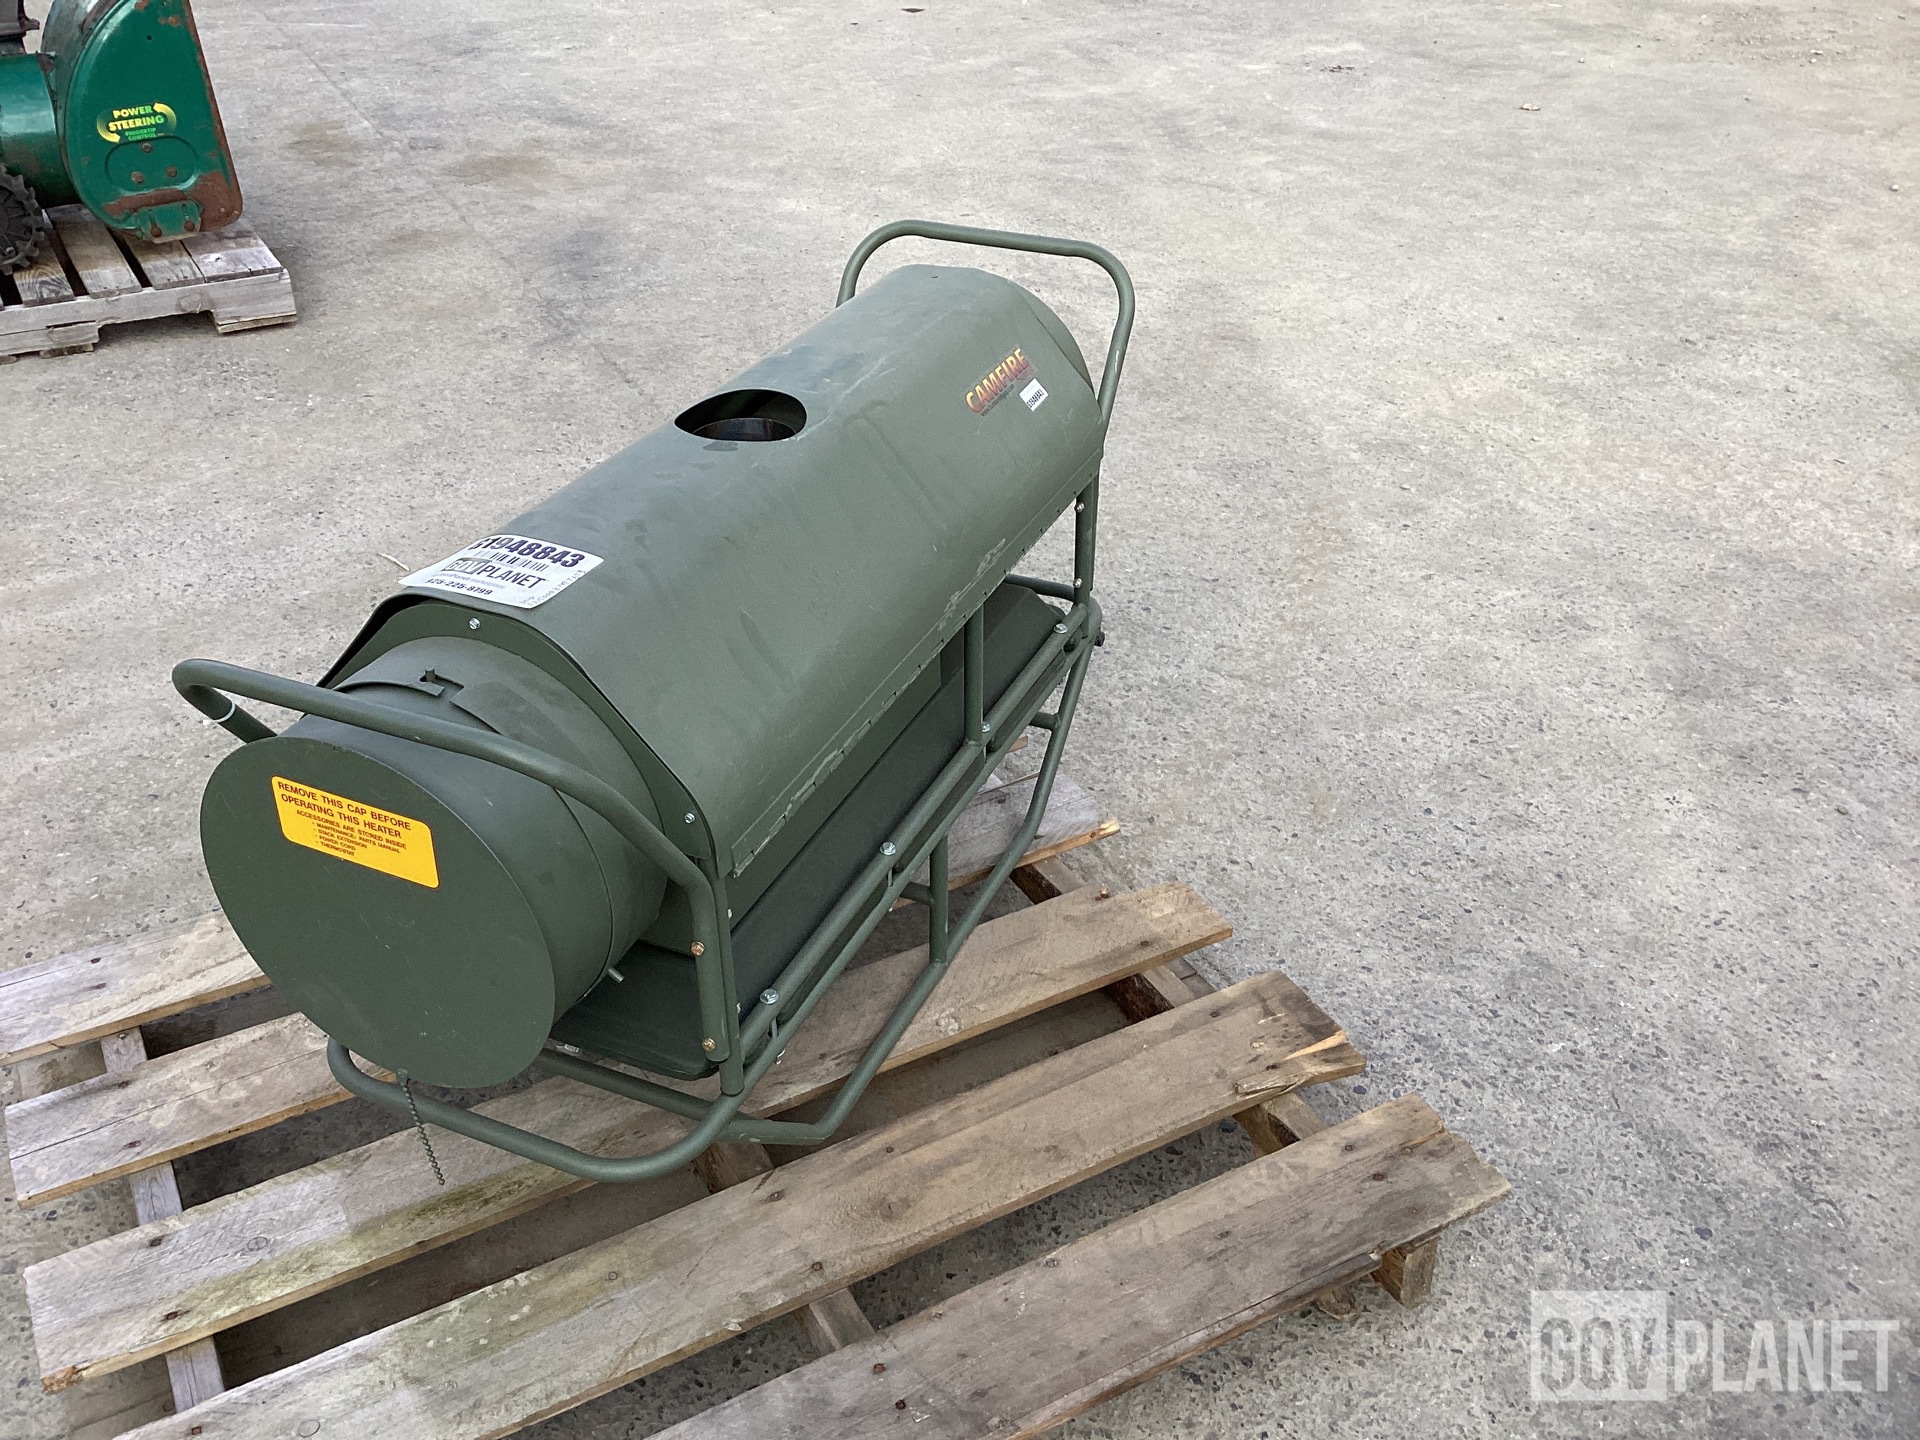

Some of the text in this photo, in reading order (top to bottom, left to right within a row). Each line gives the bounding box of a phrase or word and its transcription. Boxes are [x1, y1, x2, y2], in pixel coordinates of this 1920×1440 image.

[108, 115, 165, 131] STEERING
[112, 105, 153, 119] POWER
[965, 347, 1030, 413] CAMFIRE
[278, 781, 411, 831] REMOVE THIS CAP BEFORE
[281, 793, 401, 838] OPERATING THIS HEATER
[297, 809, 407, 849] ACCESSORIES ARE STORED INSIDE
[319, 835, 356, 851] POWER CORD
[359, 836, 377, 846] PARTS
